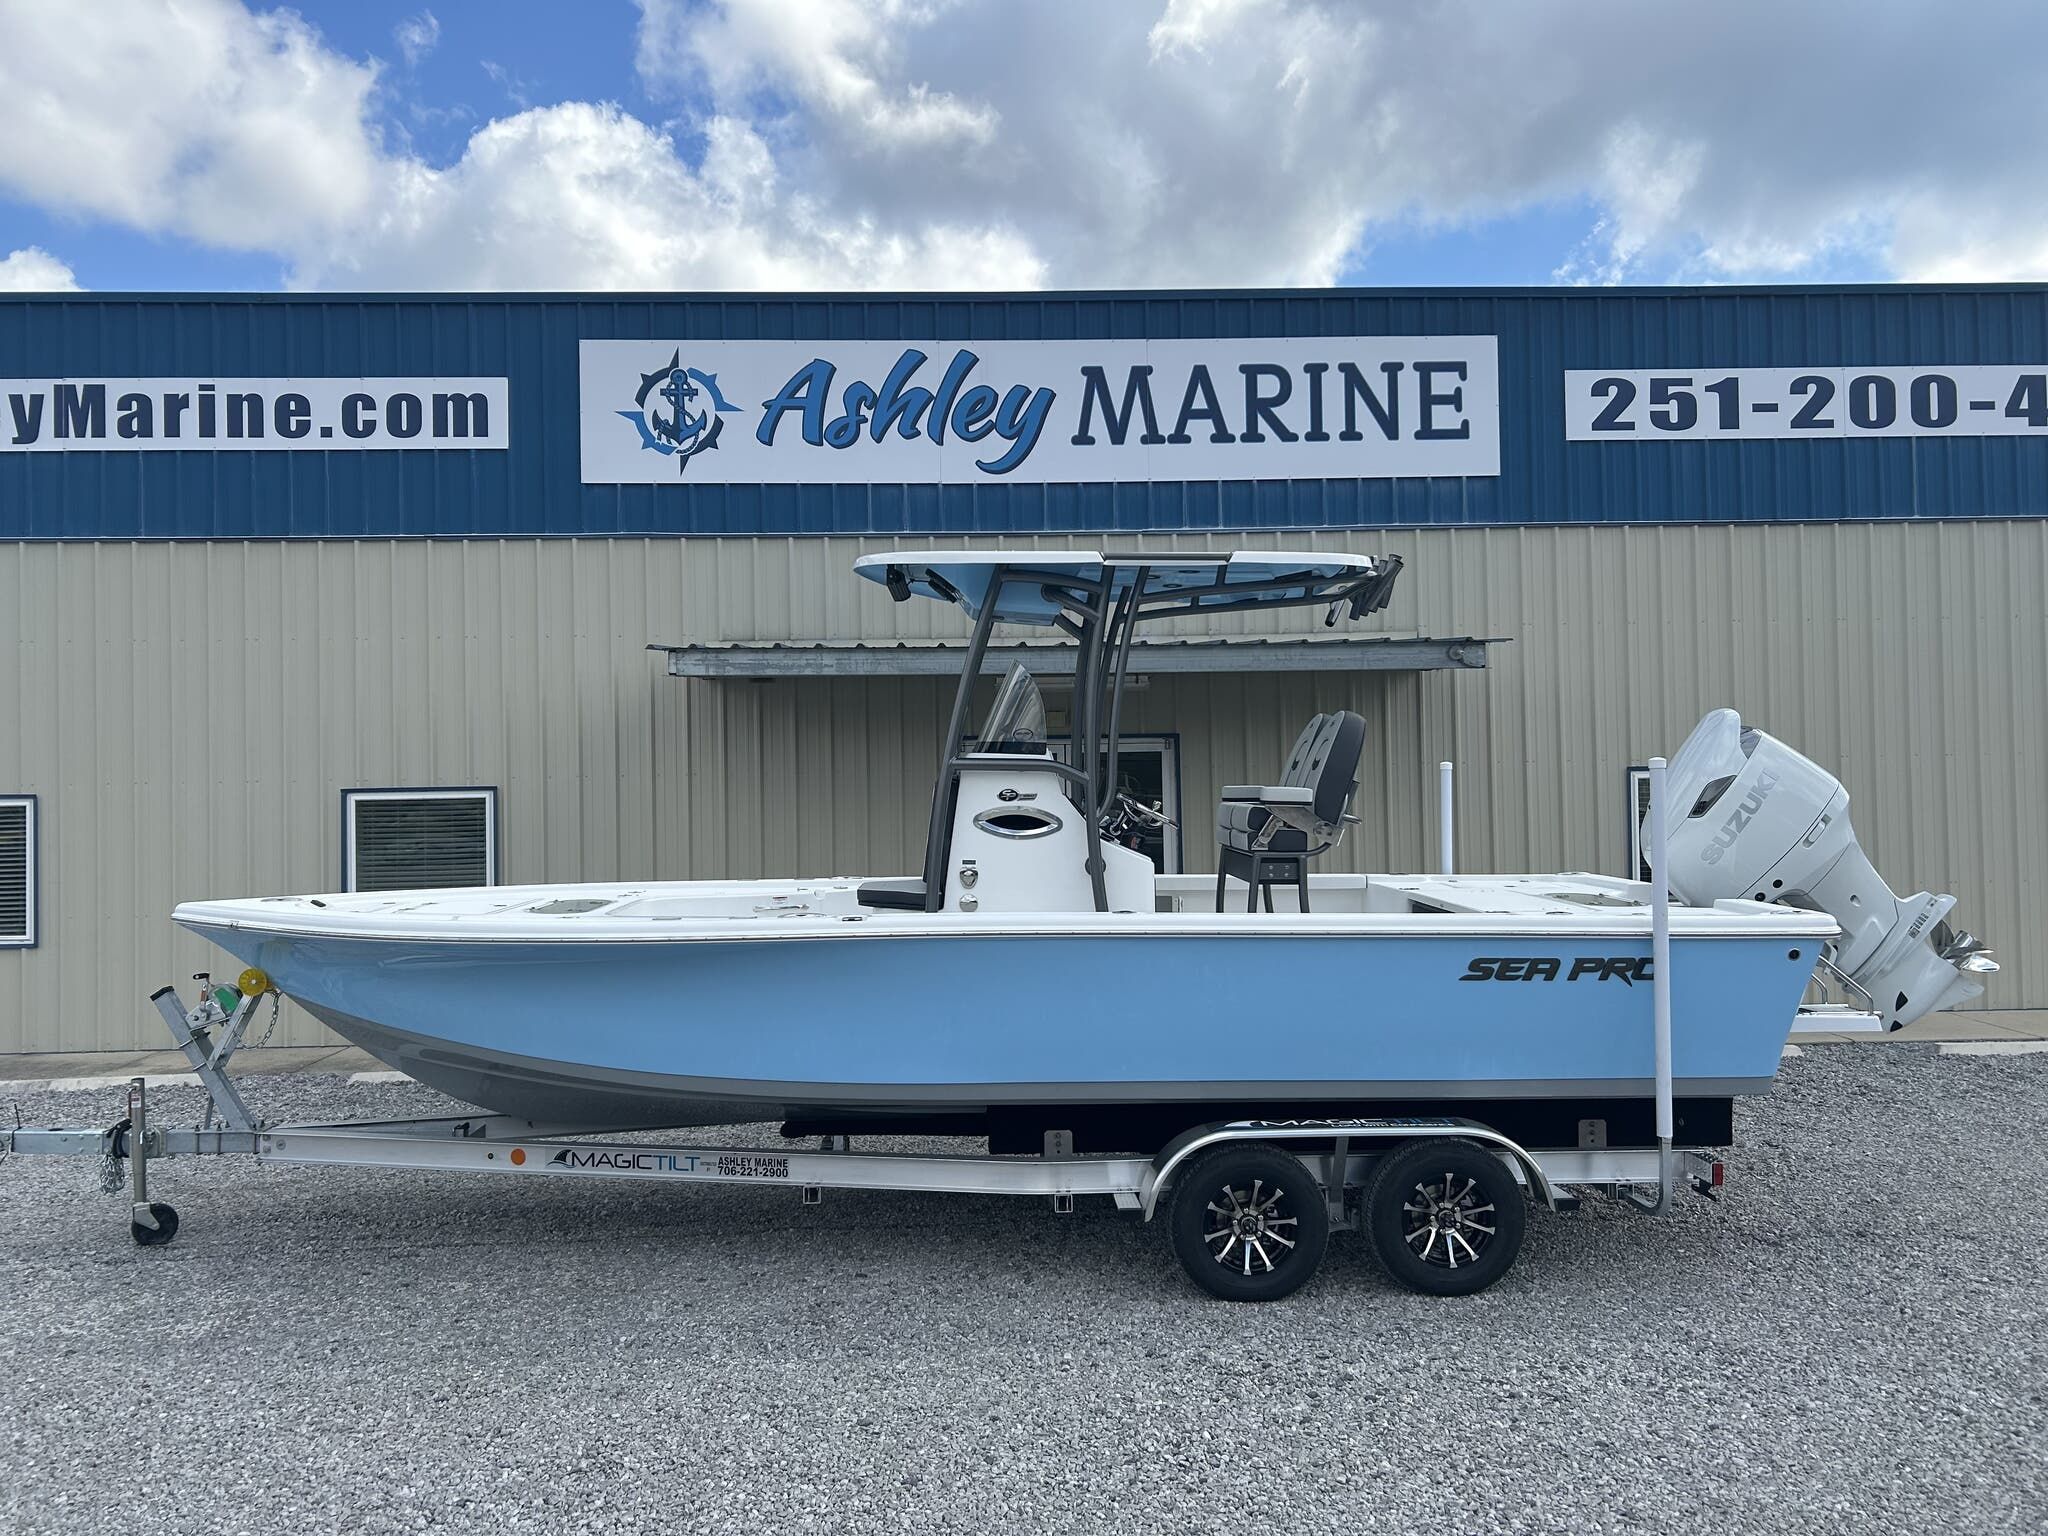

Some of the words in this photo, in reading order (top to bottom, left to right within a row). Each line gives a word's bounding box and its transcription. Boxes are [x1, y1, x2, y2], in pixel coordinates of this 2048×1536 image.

[11, 384, 490, 445] yMarine.com
[756, 348, 1056, 475] Ashley
[1071, 360, 1470, 446] MARINE
[1590, 374, 2048, 431] 251-200-4
[1700, 768, 1778, 865] SUZUKI
[1458, 957, 1561, 981] SEA
[571, 1151, 701, 1172] MAGICTILT
[717, 1166, 789, 1178] 706-221-2900
[718, 1156, 752, 1167] ASHLEY
[754, 1157, 789, 1168] MARINE
